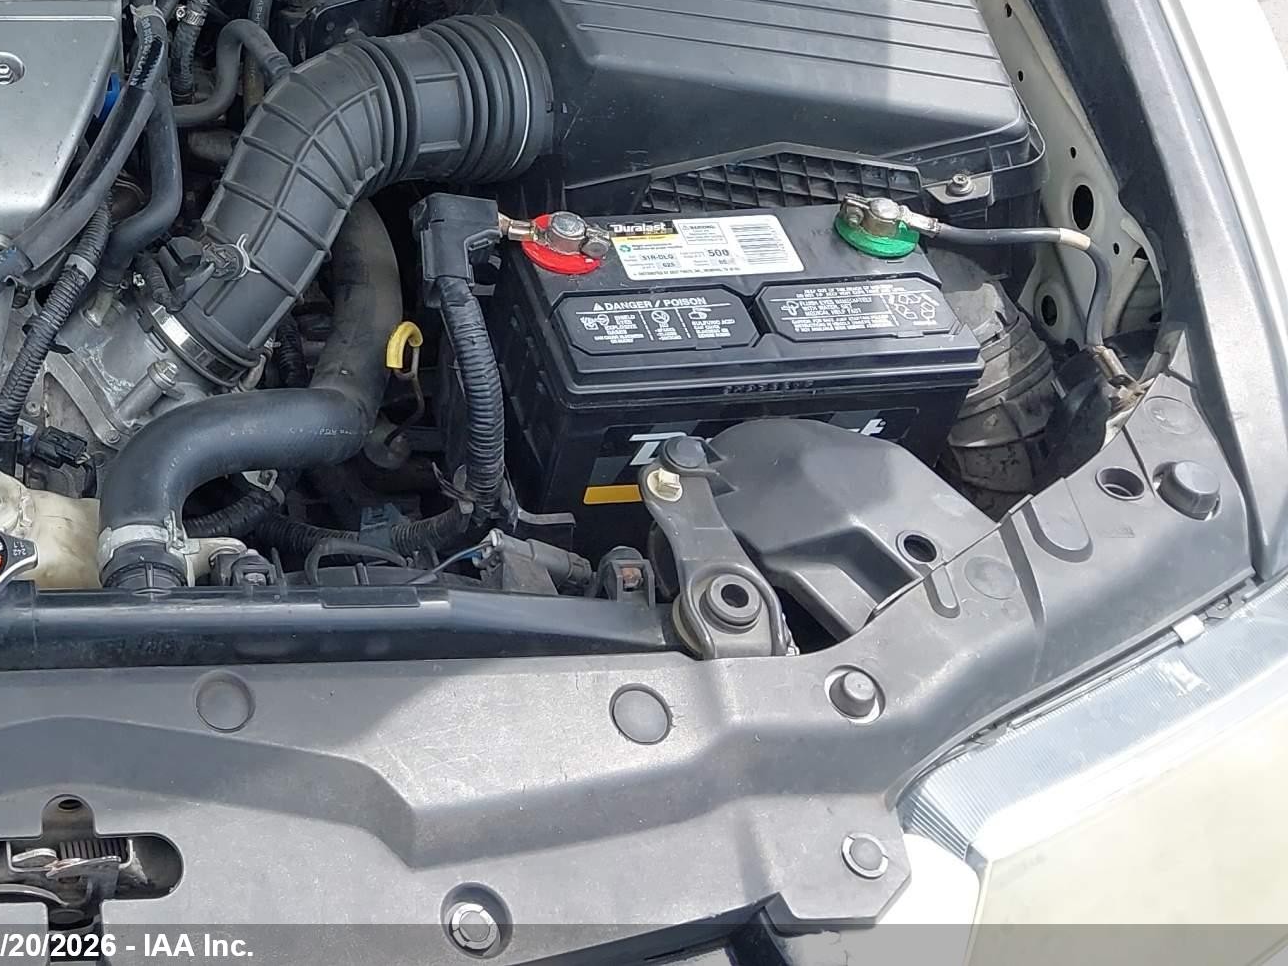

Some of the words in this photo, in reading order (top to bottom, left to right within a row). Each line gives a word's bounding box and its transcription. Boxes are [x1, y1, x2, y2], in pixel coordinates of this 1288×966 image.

[610, 221, 667, 234] Duralast
[708, 249, 730, 258] 500
[604, 300, 653, 310] DANGER
[663, 297, 706, 306] POISON
